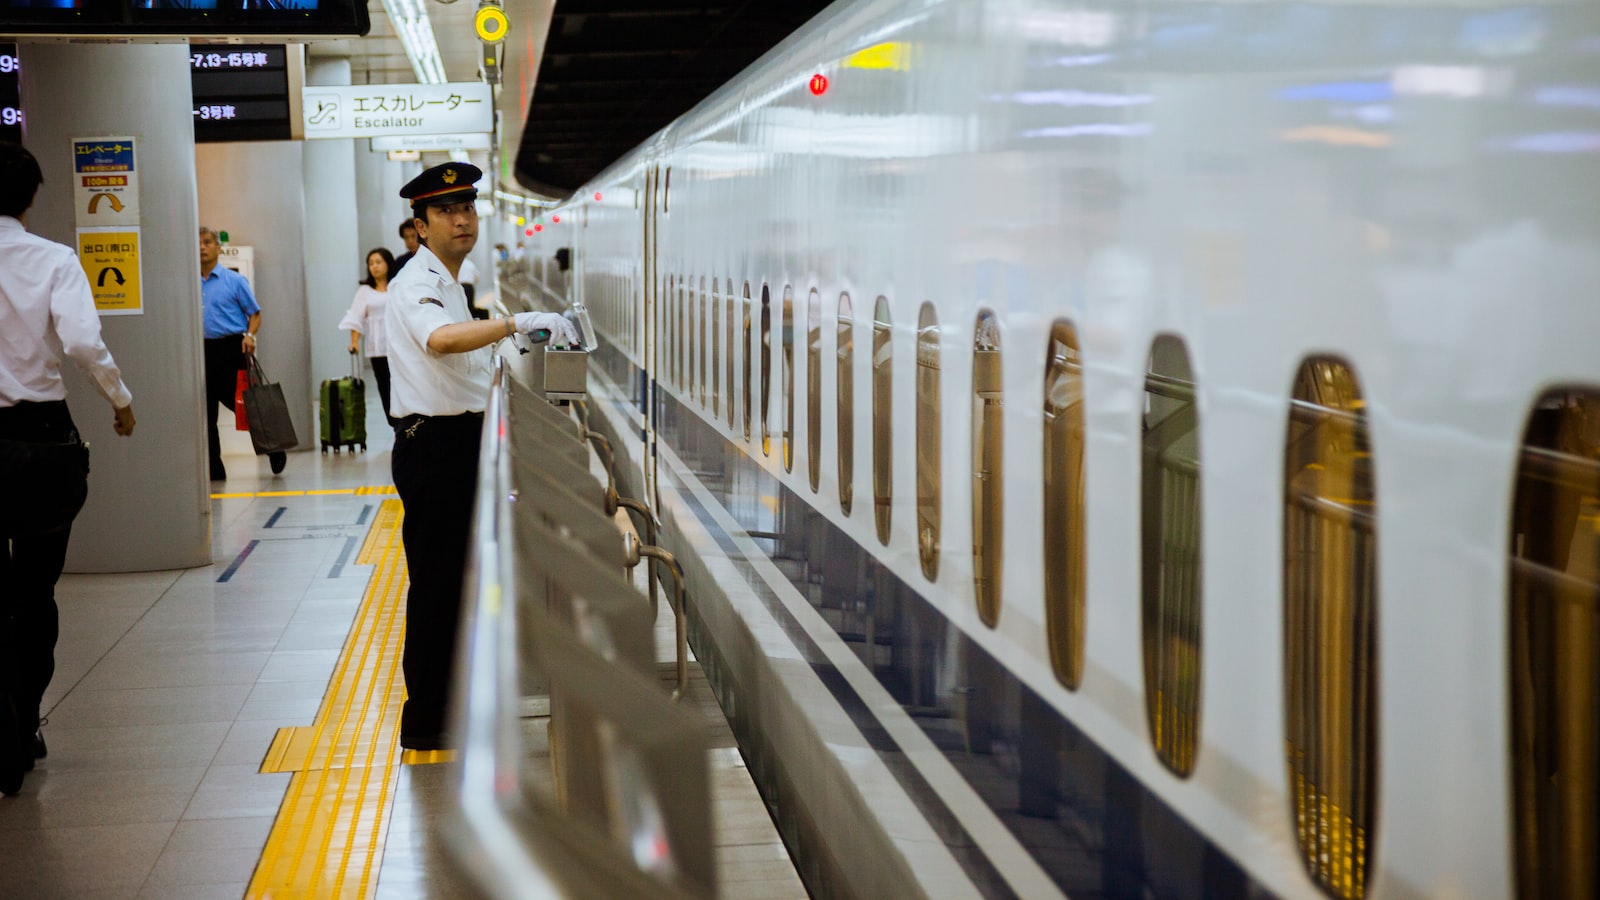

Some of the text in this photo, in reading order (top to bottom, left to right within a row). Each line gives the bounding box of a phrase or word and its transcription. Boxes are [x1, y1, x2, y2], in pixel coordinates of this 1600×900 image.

[353, 93, 482, 112] エスカレーター
[354, 117, 424, 129] Escalator
[76, 144, 132, 155] エレベーター
